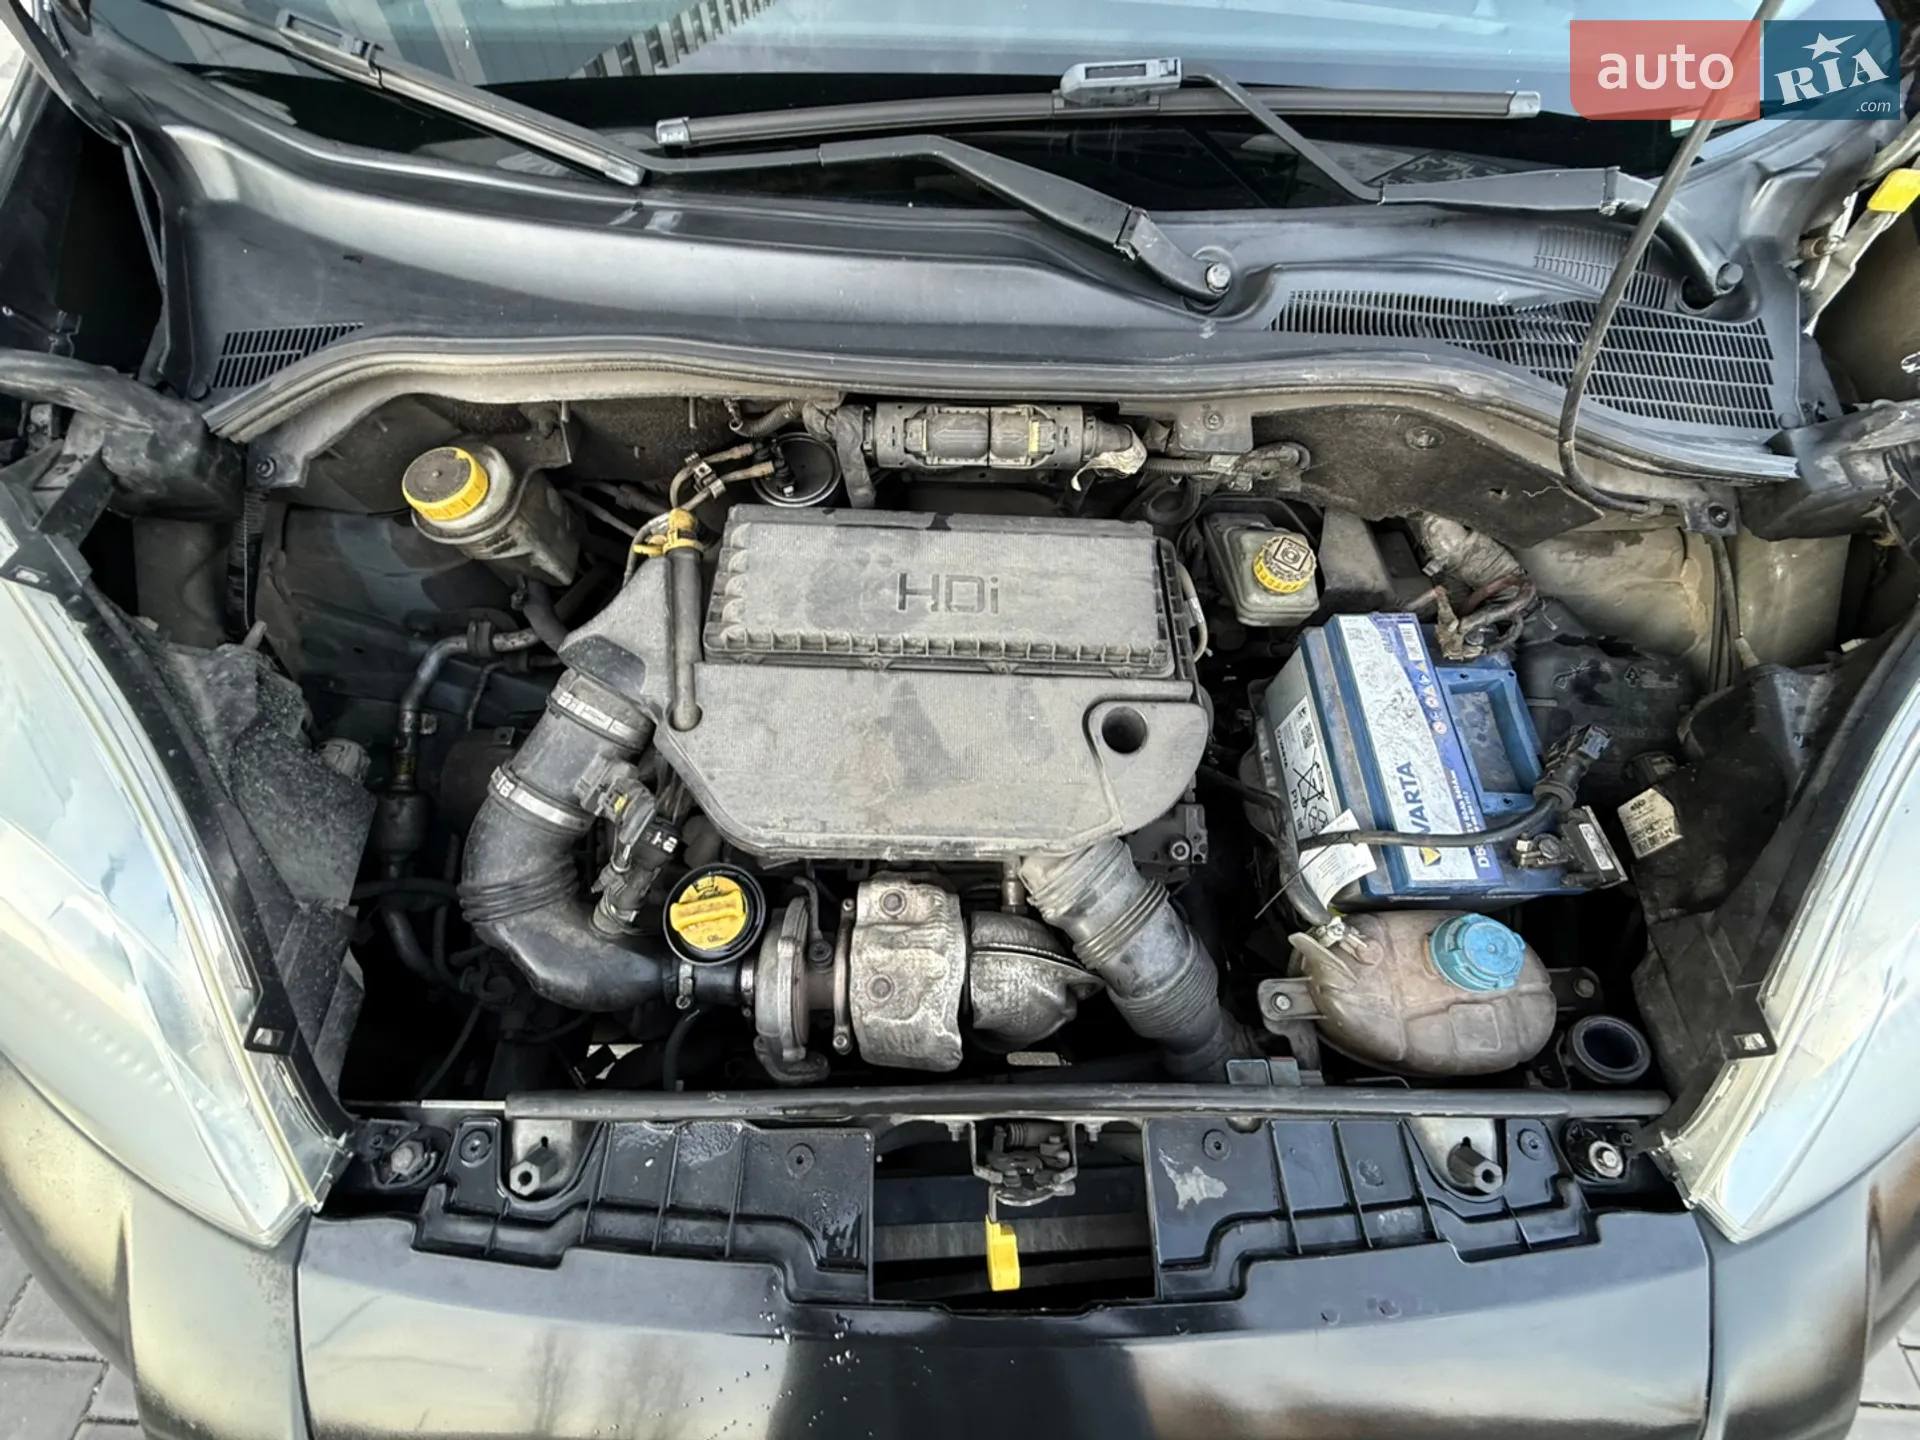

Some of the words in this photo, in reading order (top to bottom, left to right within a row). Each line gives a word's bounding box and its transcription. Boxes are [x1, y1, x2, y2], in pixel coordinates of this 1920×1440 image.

[898, 573, 998, 614] HDi
[1291, 789, 1299, 810] Pb
[1397, 762, 1431, 833] VARTA
[1473, 842, 1491, 869] D5
